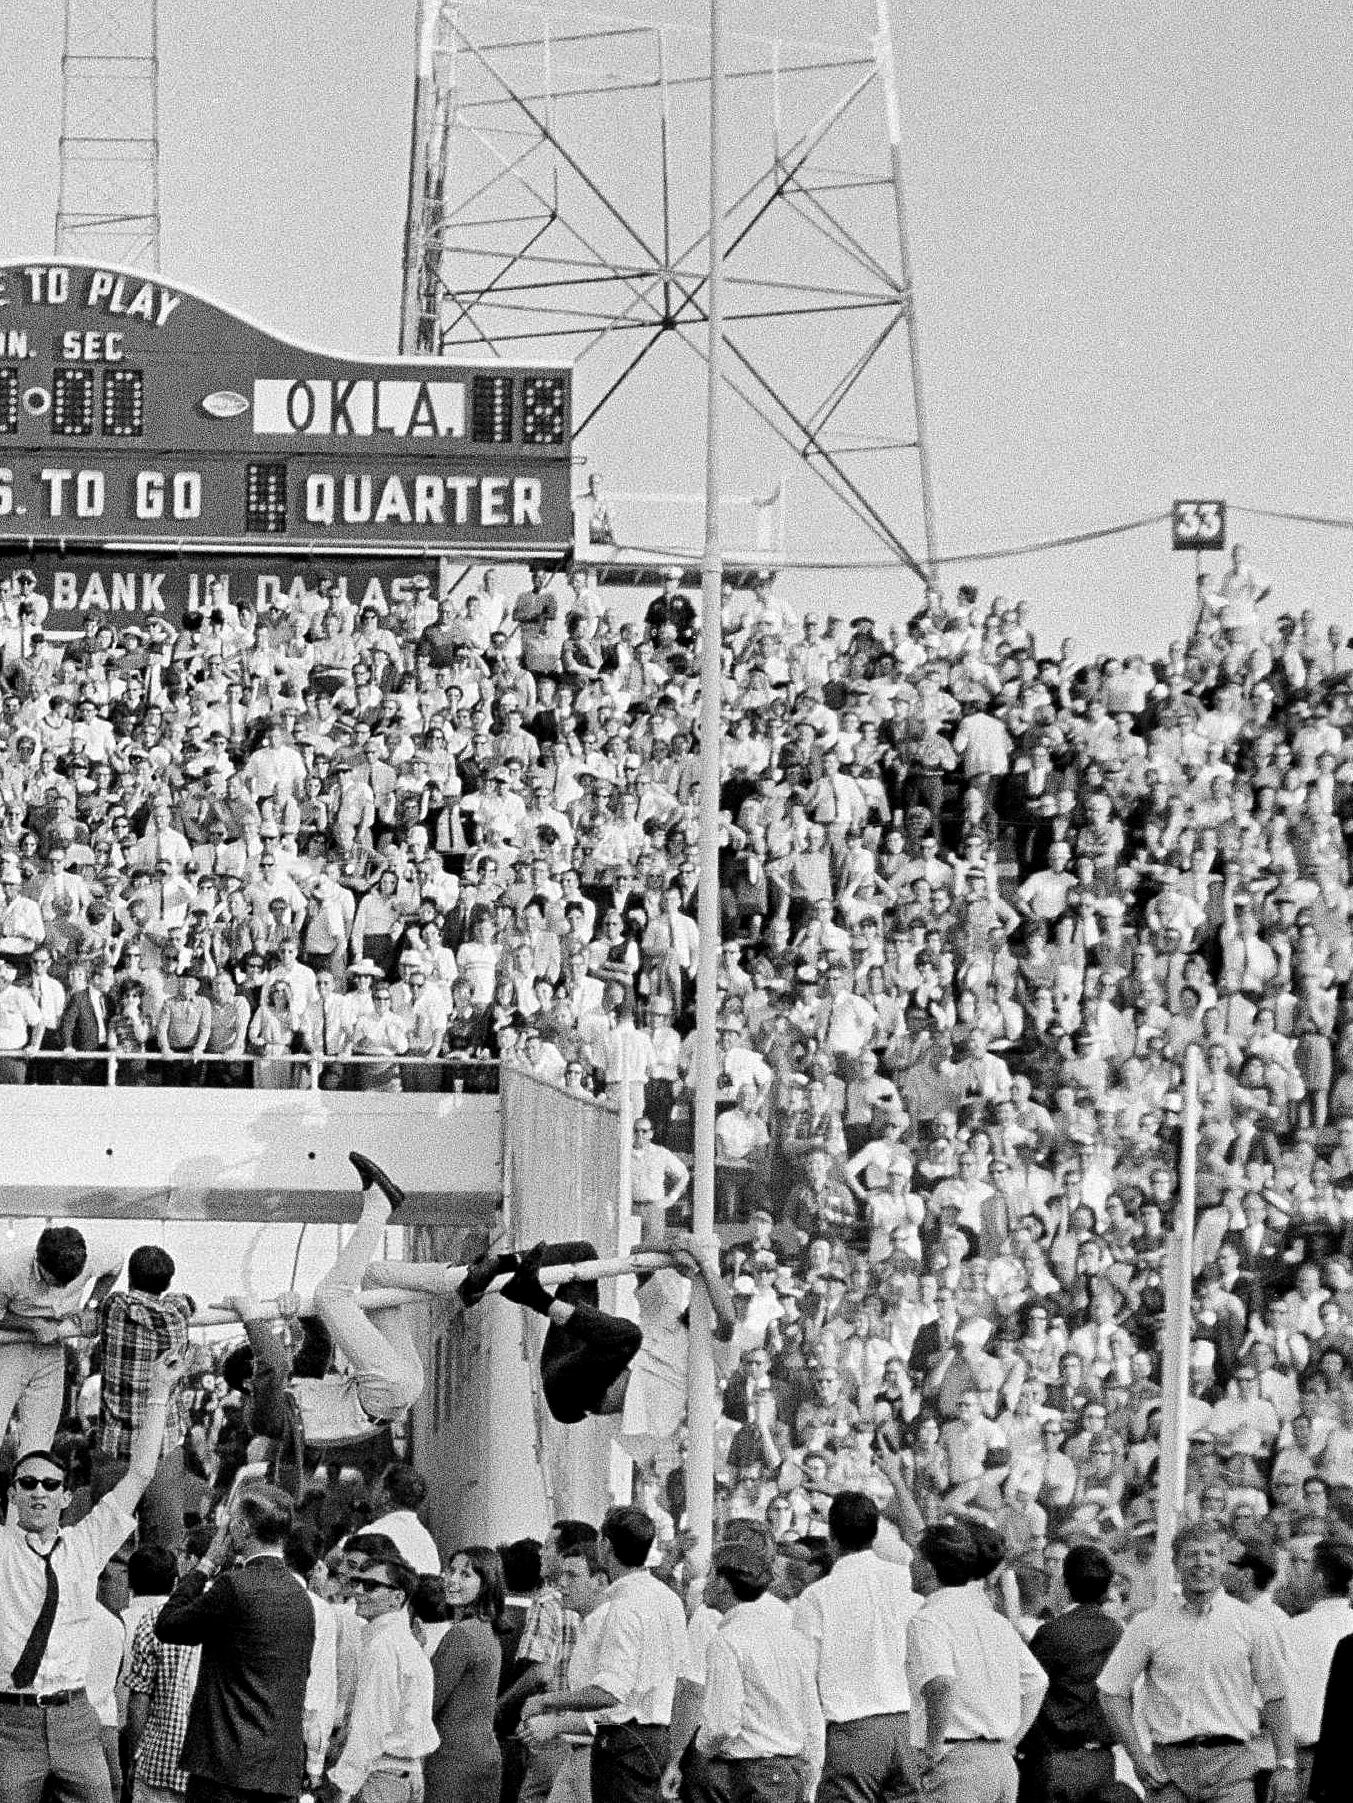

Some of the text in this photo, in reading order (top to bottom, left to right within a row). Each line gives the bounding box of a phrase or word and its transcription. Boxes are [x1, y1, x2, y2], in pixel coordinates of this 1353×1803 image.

[24, 267, 70, 303] TO
[87, 271, 181, 326] PLAY
[286, 380, 455, 438] OKLA.
[492, 378, 562, 442] 18
[42, 468, 104, 517] TO
[136, 470, 201, 519] GO
[247, 465, 285, 531] 4
[306, 474, 542, 526] QUARTER
[1178, 503, 1221, 538] 33
[53, 571, 166, 612] BANK
